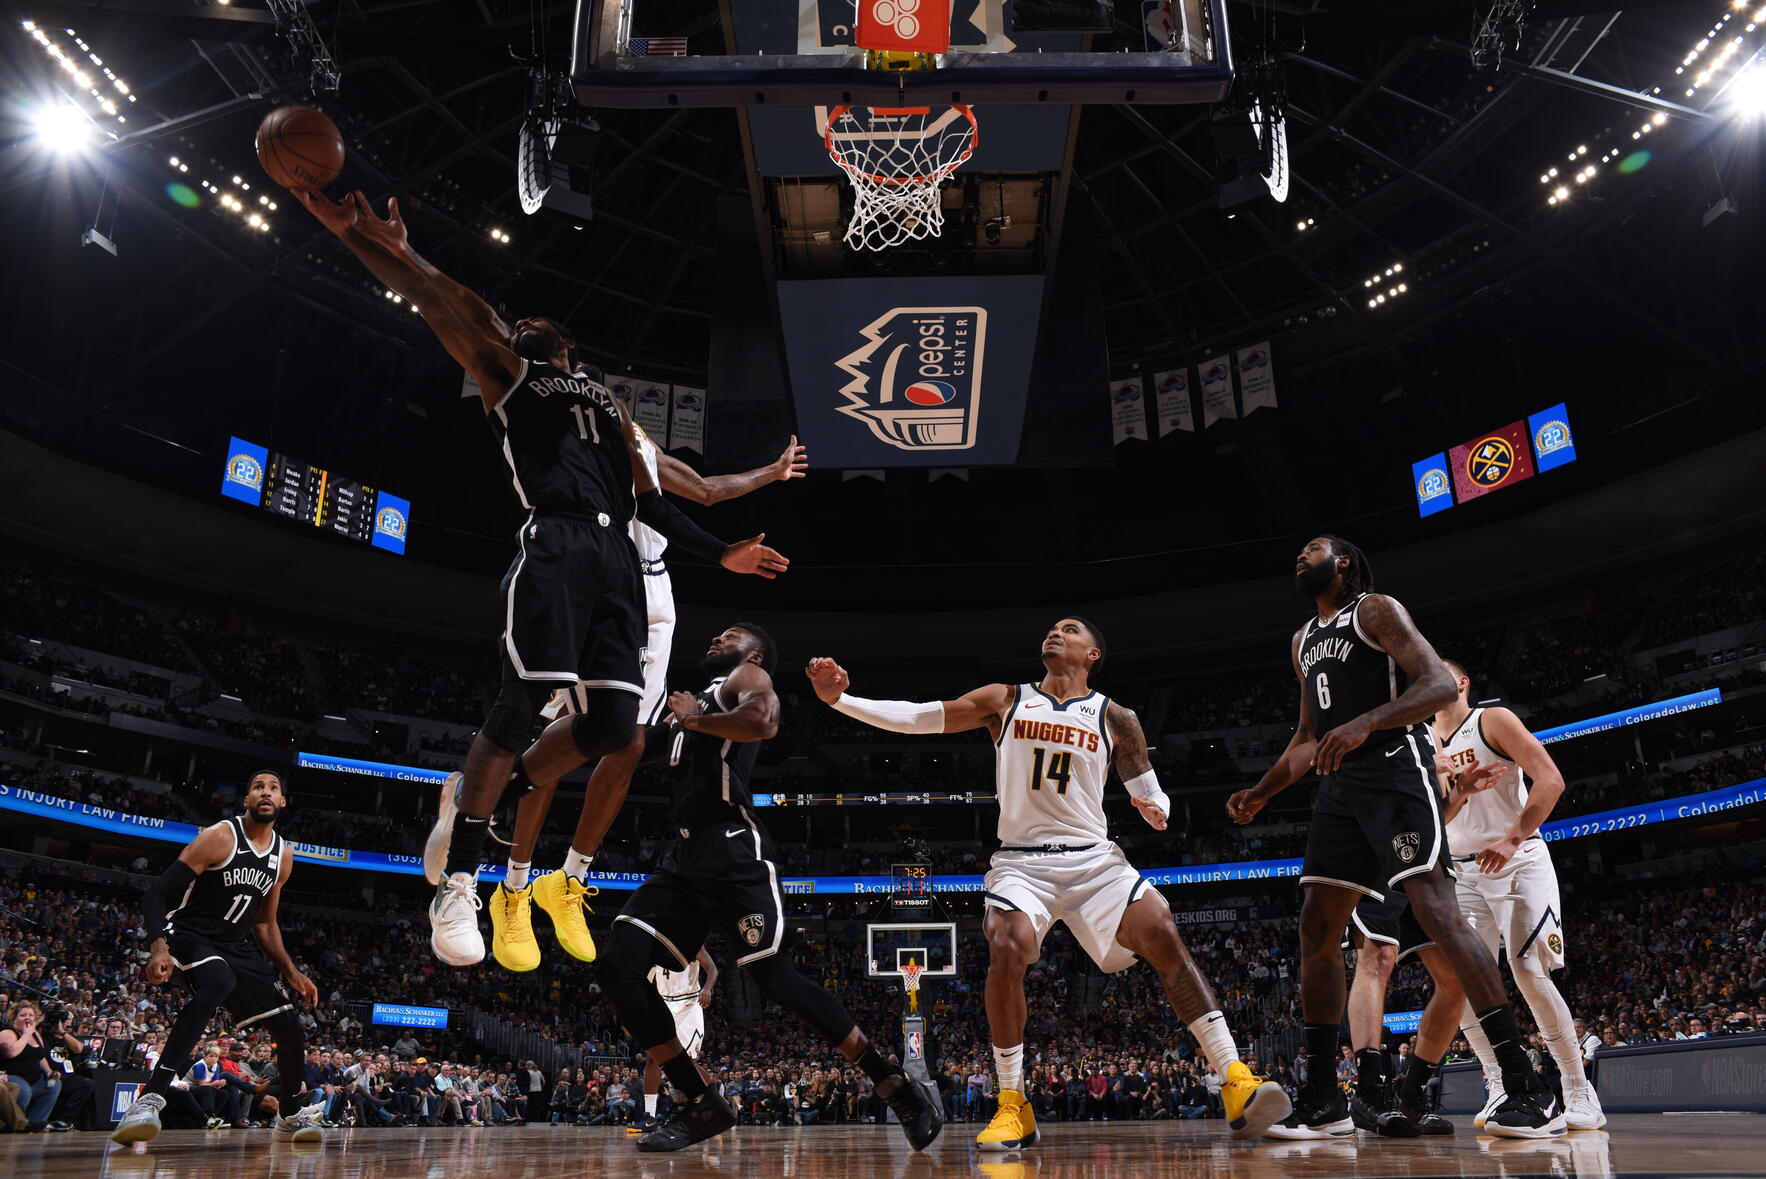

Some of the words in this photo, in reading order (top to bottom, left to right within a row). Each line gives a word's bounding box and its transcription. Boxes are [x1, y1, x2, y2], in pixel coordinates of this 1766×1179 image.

[912, 319, 952, 377] pepsi
[953, 319, 969, 376] CENTER
[528, 376, 617, 418] BROOKLYN
[569, 403, 601, 445] 11
[1544, 429, 1562, 448] 22
[236, 463, 255, 479] 22
[1425, 476, 1441, 493] 22
[383, 515, 399, 531] 22
[1302, 637, 1354, 678] BROOKLYN
[1316, 671, 1331, 710] 6
[1079, 704, 1096, 716] WU
[1625, 696, 1720, 726] ColoradoLaw.net
[1013, 719, 1100, 753] NUGGETS
[669, 731, 685, 767] 0
[397, 772, 445, 786] ColoradoL
[1031, 747, 1072, 795] 14
[16, 788, 76, 811] INJURY
[82, 803, 115, 820] LAW
[121, 813, 165, 829] FIRM
[1572, 813, 1648, 837] 222-2222
[294, 842, 344, 858] JUSTICE
[1393, 832, 1419, 850] NETS
[222, 867, 274, 897] BROOKLYN
[904, 867, 926, 878] 7:25
[1177, 871, 1232, 884] INJURY
[1277, 864, 1305, 877] FIR
[784, 885, 811, 894] TICE
[223, 893, 253, 924] 17
[739, 915, 763, 934] NETS
[402, 1016, 436, 1026] 222-2222
